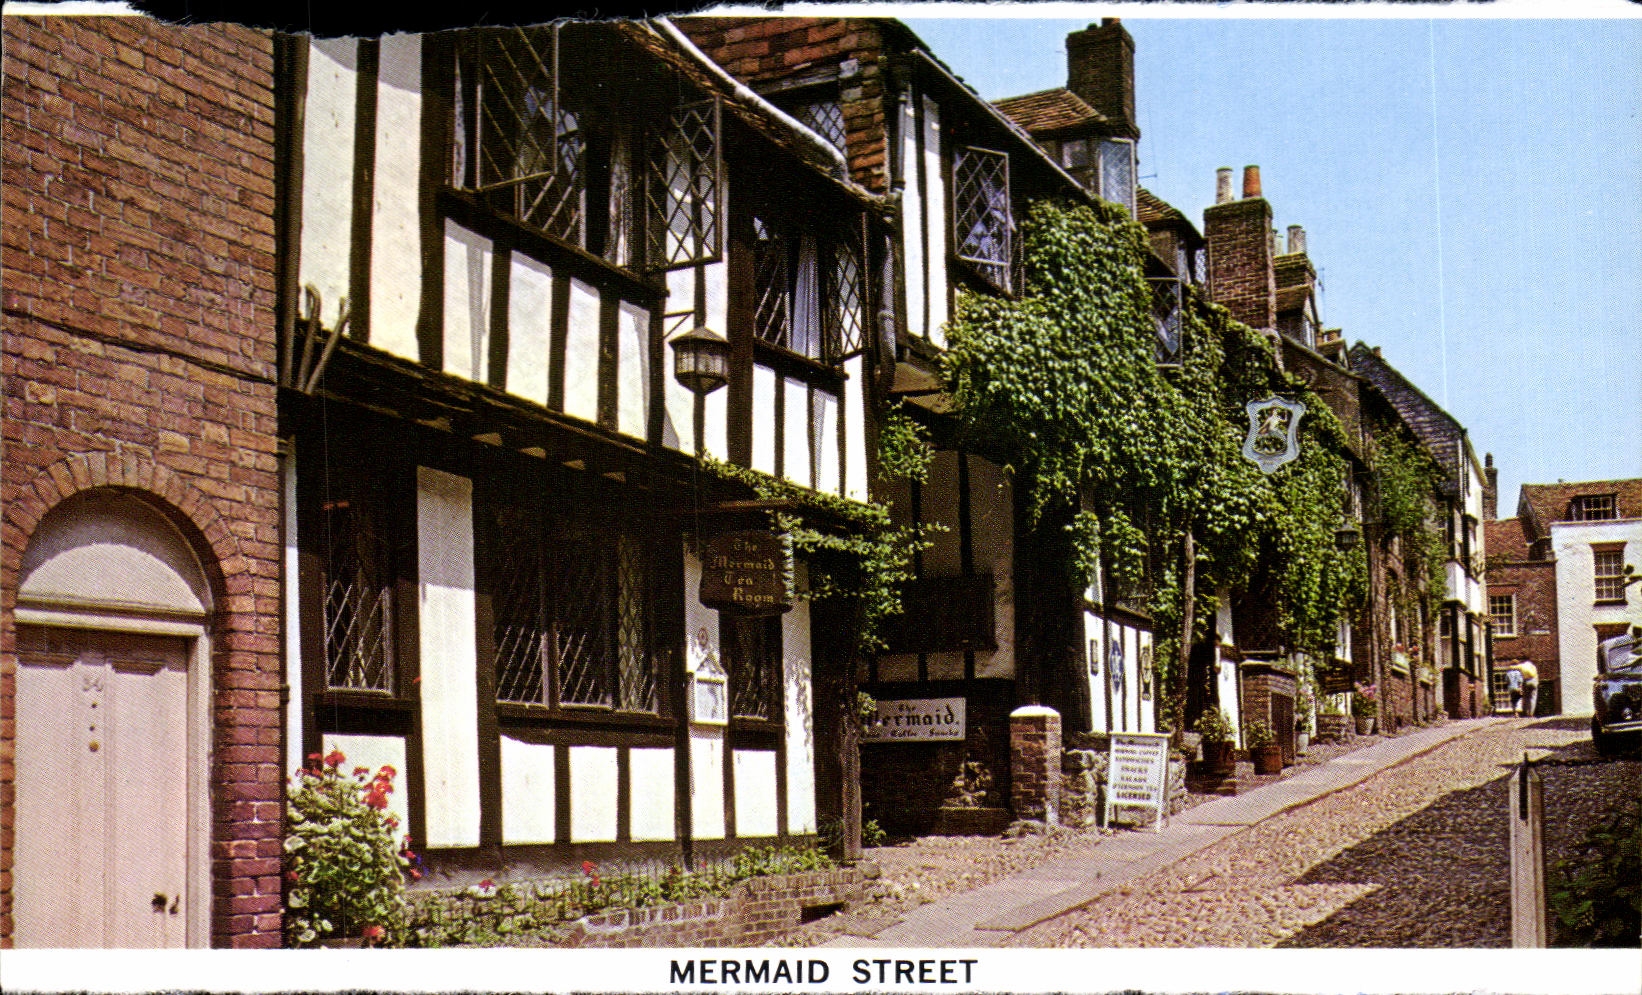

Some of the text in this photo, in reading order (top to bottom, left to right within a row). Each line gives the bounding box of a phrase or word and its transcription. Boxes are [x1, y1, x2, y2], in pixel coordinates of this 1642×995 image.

[733, 538, 758, 552] The
[710, 556, 775, 570] Mermaid
[723, 571, 754, 585] Tea
[732, 587, 774, 603] Room
[1116, 792, 1152, 801] LICENSED
